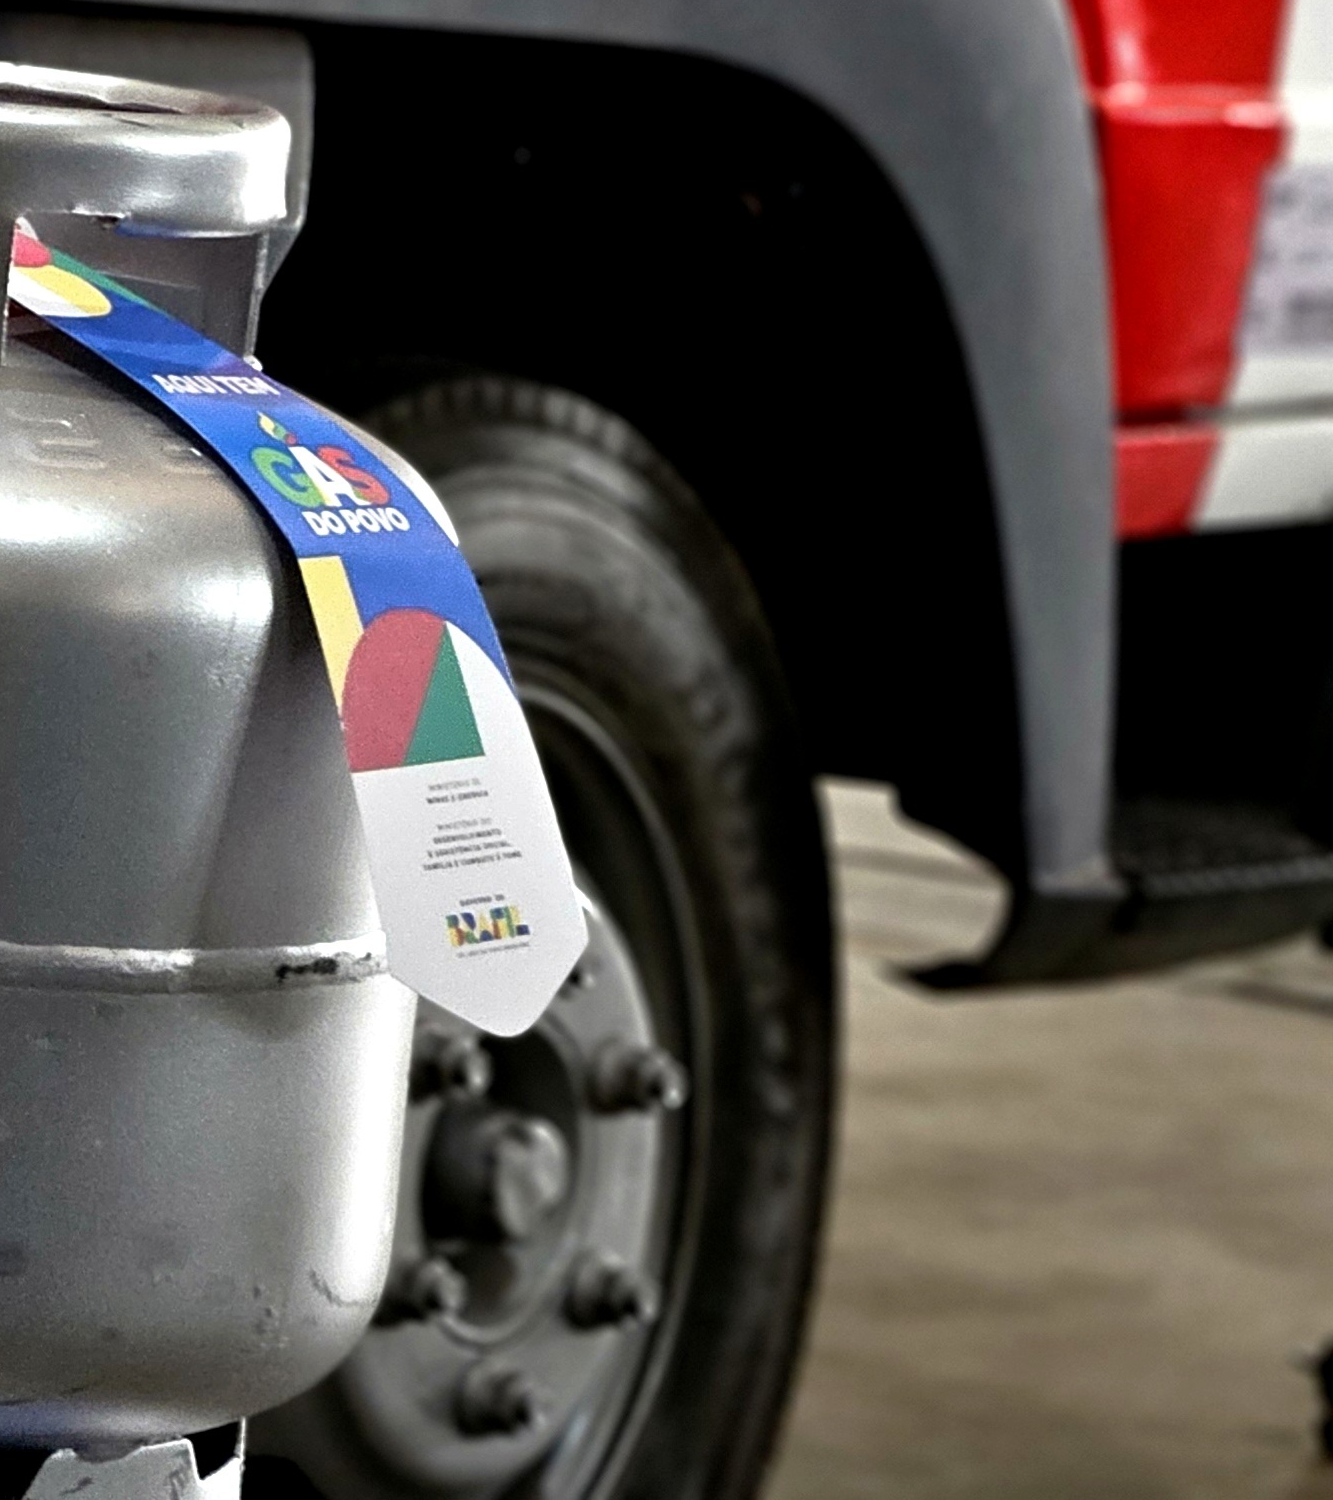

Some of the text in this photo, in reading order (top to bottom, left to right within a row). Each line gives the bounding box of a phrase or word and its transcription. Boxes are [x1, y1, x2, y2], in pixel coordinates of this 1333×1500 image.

[151, 374, 281, 396] AQUI TEM
[302, 507, 410, 536] DO POVO
